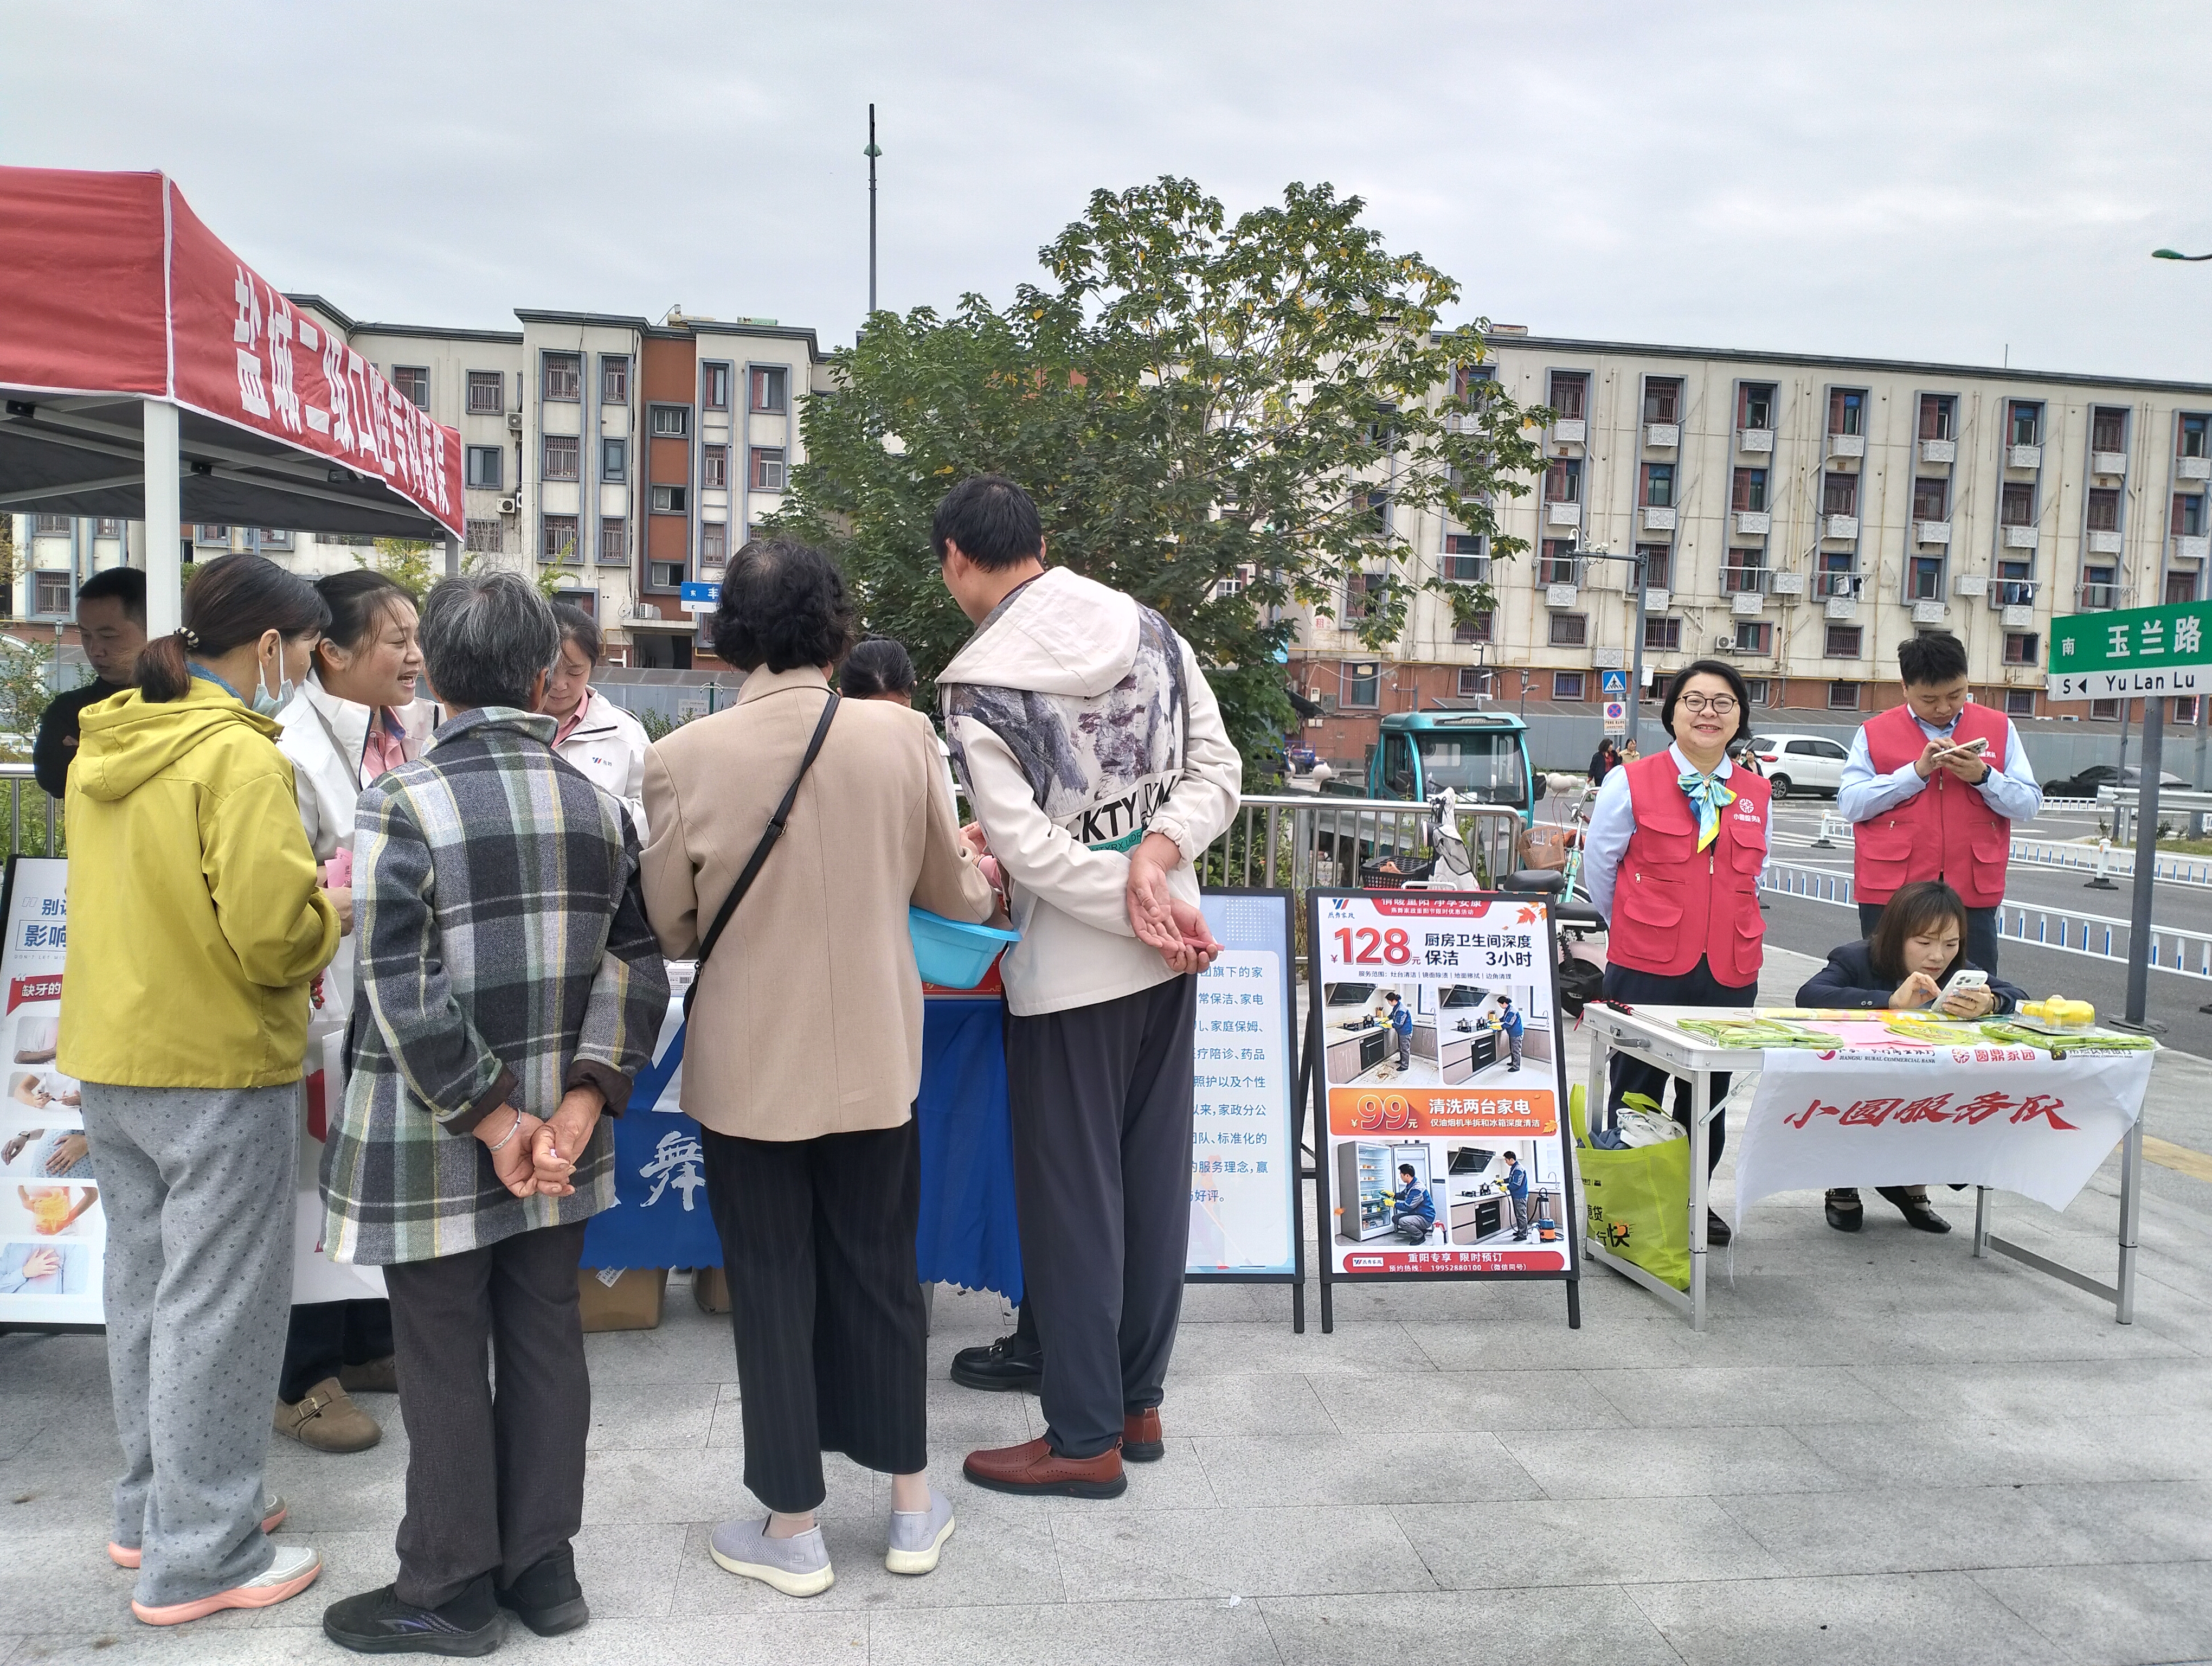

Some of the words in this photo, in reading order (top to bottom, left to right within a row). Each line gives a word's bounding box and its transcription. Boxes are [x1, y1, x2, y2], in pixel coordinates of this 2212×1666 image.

[233, 264, 450, 515] 盐城二级口腔专科医院
[2062, 637, 2075, 657] 南
[2106, 616, 2202, 658] 玉兰路
[2063, 678, 2070, 694] S
[2106, 675, 2126, 691] Yu
[2134, 674, 2164, 690] Lan
[2174, 671, 2195, 688] Lu
[1425, 933, 1532, 949] 厨房卫生间深度
[1425, 951, 1459, 966] 保洁
[1486, 951, 1532, 967] 3小时
[1197, 966, 1263, 978] 团旗下的家
[22, 982, 61, 997] 缺牙的
[1199, 993, 1264, 1005] 常保洁、家电
[1193, 1048, 1265, 1060] 疗陪诊、药品
[1975, 1049, 2035, 1062] 圆鼎家园
[1193, 1075, 1266, 1088] 照护以及个性
[1429, 1098, 1531, 1115] 清洗两台家电
[1784, 1091, 2081, 1130] 小圆服务队
[1430, 1118, 1540, 1128] 仅油烟机半拆和冰箱深度清洁
[1408, 1253, 1452, 1263] 重阳专享
[1459, 1252, 1503, 1263] 限时预订
